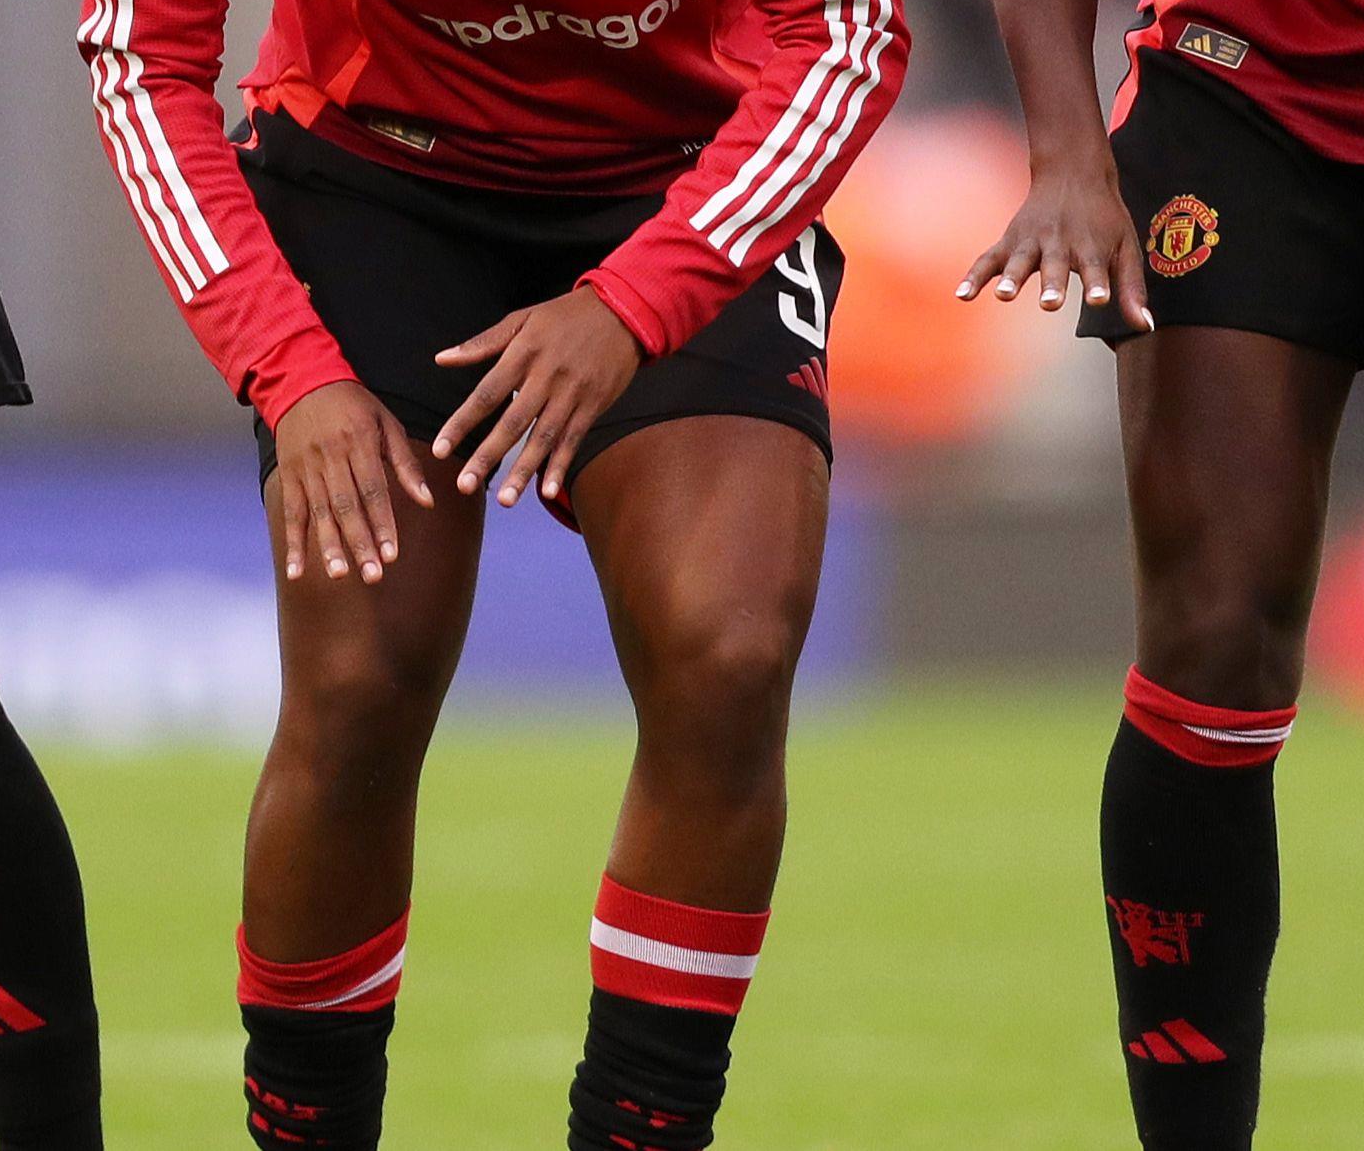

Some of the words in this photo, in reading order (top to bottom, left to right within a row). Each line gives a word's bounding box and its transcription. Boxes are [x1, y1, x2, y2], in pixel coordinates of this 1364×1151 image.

[1154, 200, 1213, 228] MANCHESTER
[1156, 256, 1198, 273] UNITED
[773, 225, 826, 350] 9
